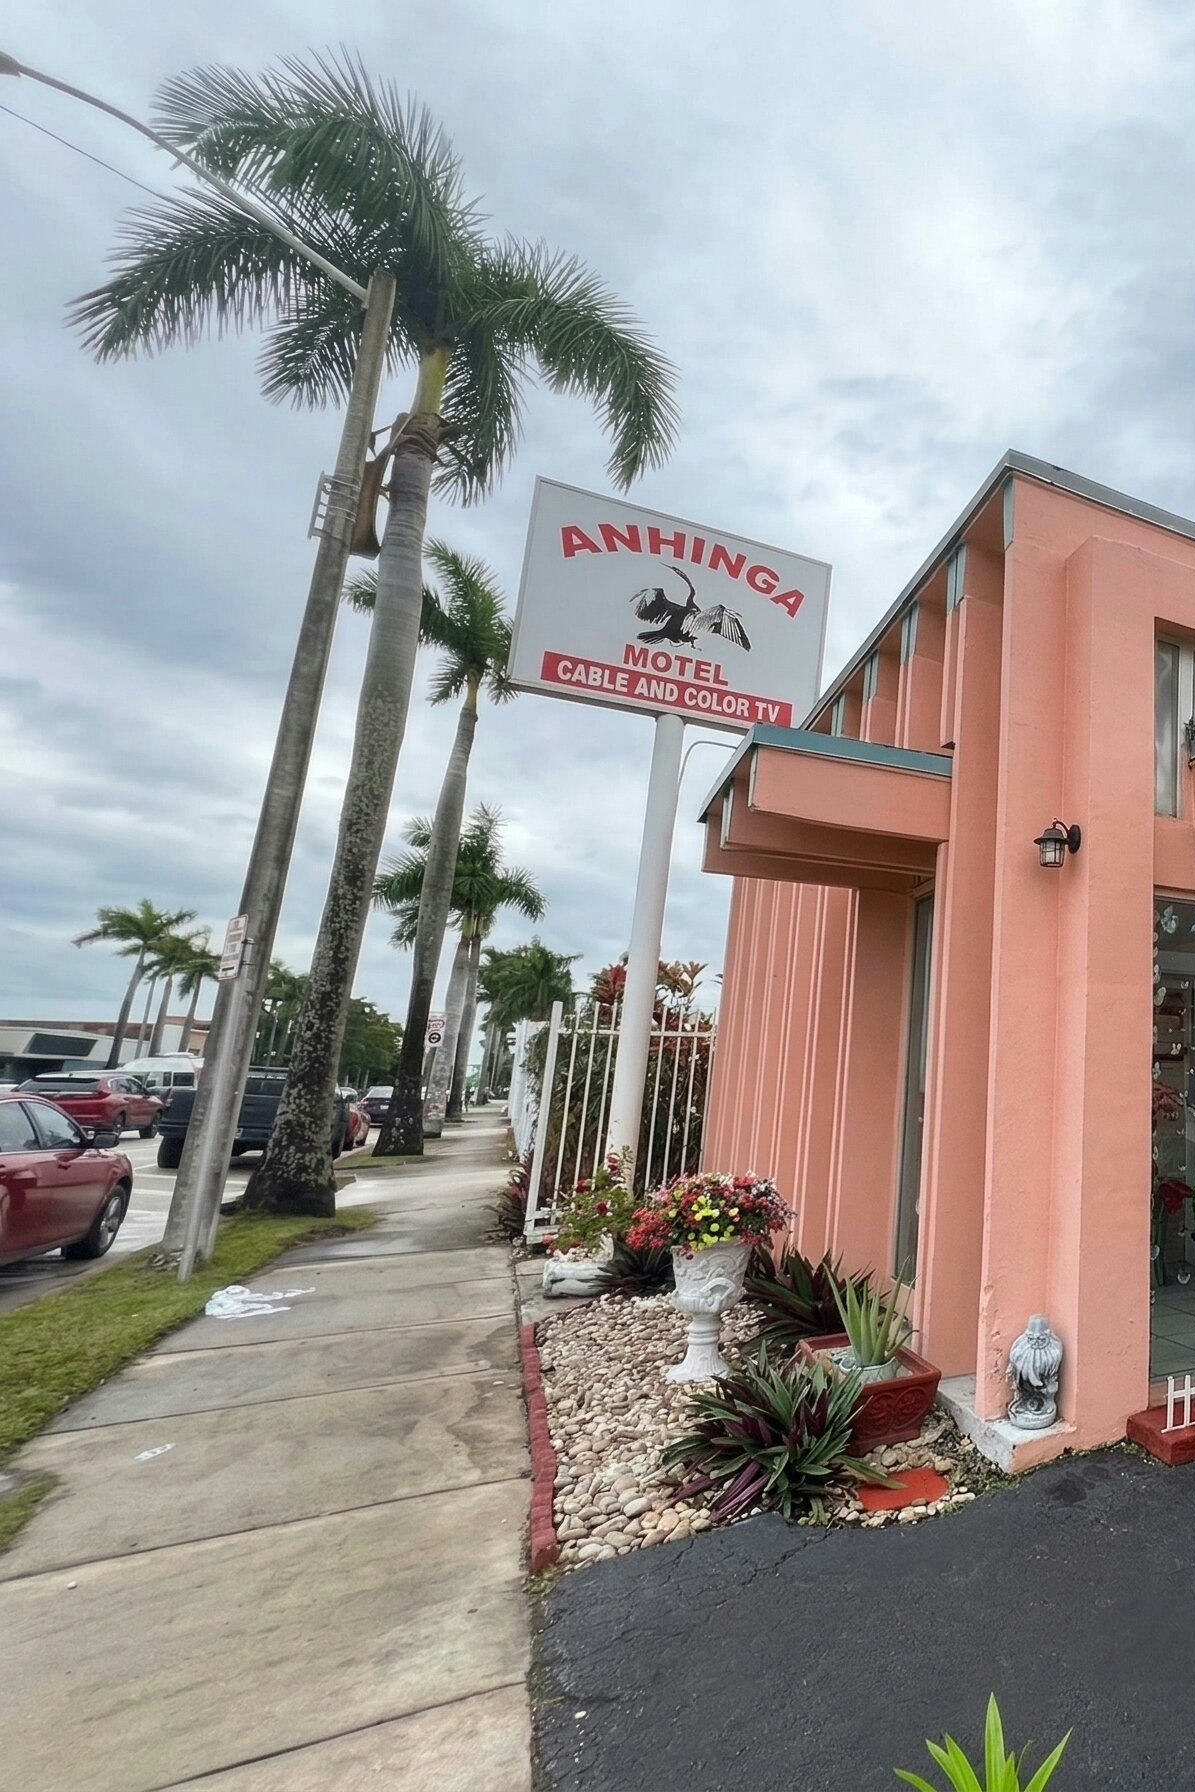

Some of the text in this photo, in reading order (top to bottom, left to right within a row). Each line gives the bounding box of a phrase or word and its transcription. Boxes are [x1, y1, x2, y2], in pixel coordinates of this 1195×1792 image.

[561, 523, 806, 618] ANHINGA
[556, 660, 781, 723] CABLE AND COLOR TV
[623, 643, 729, 687] MOTEL
